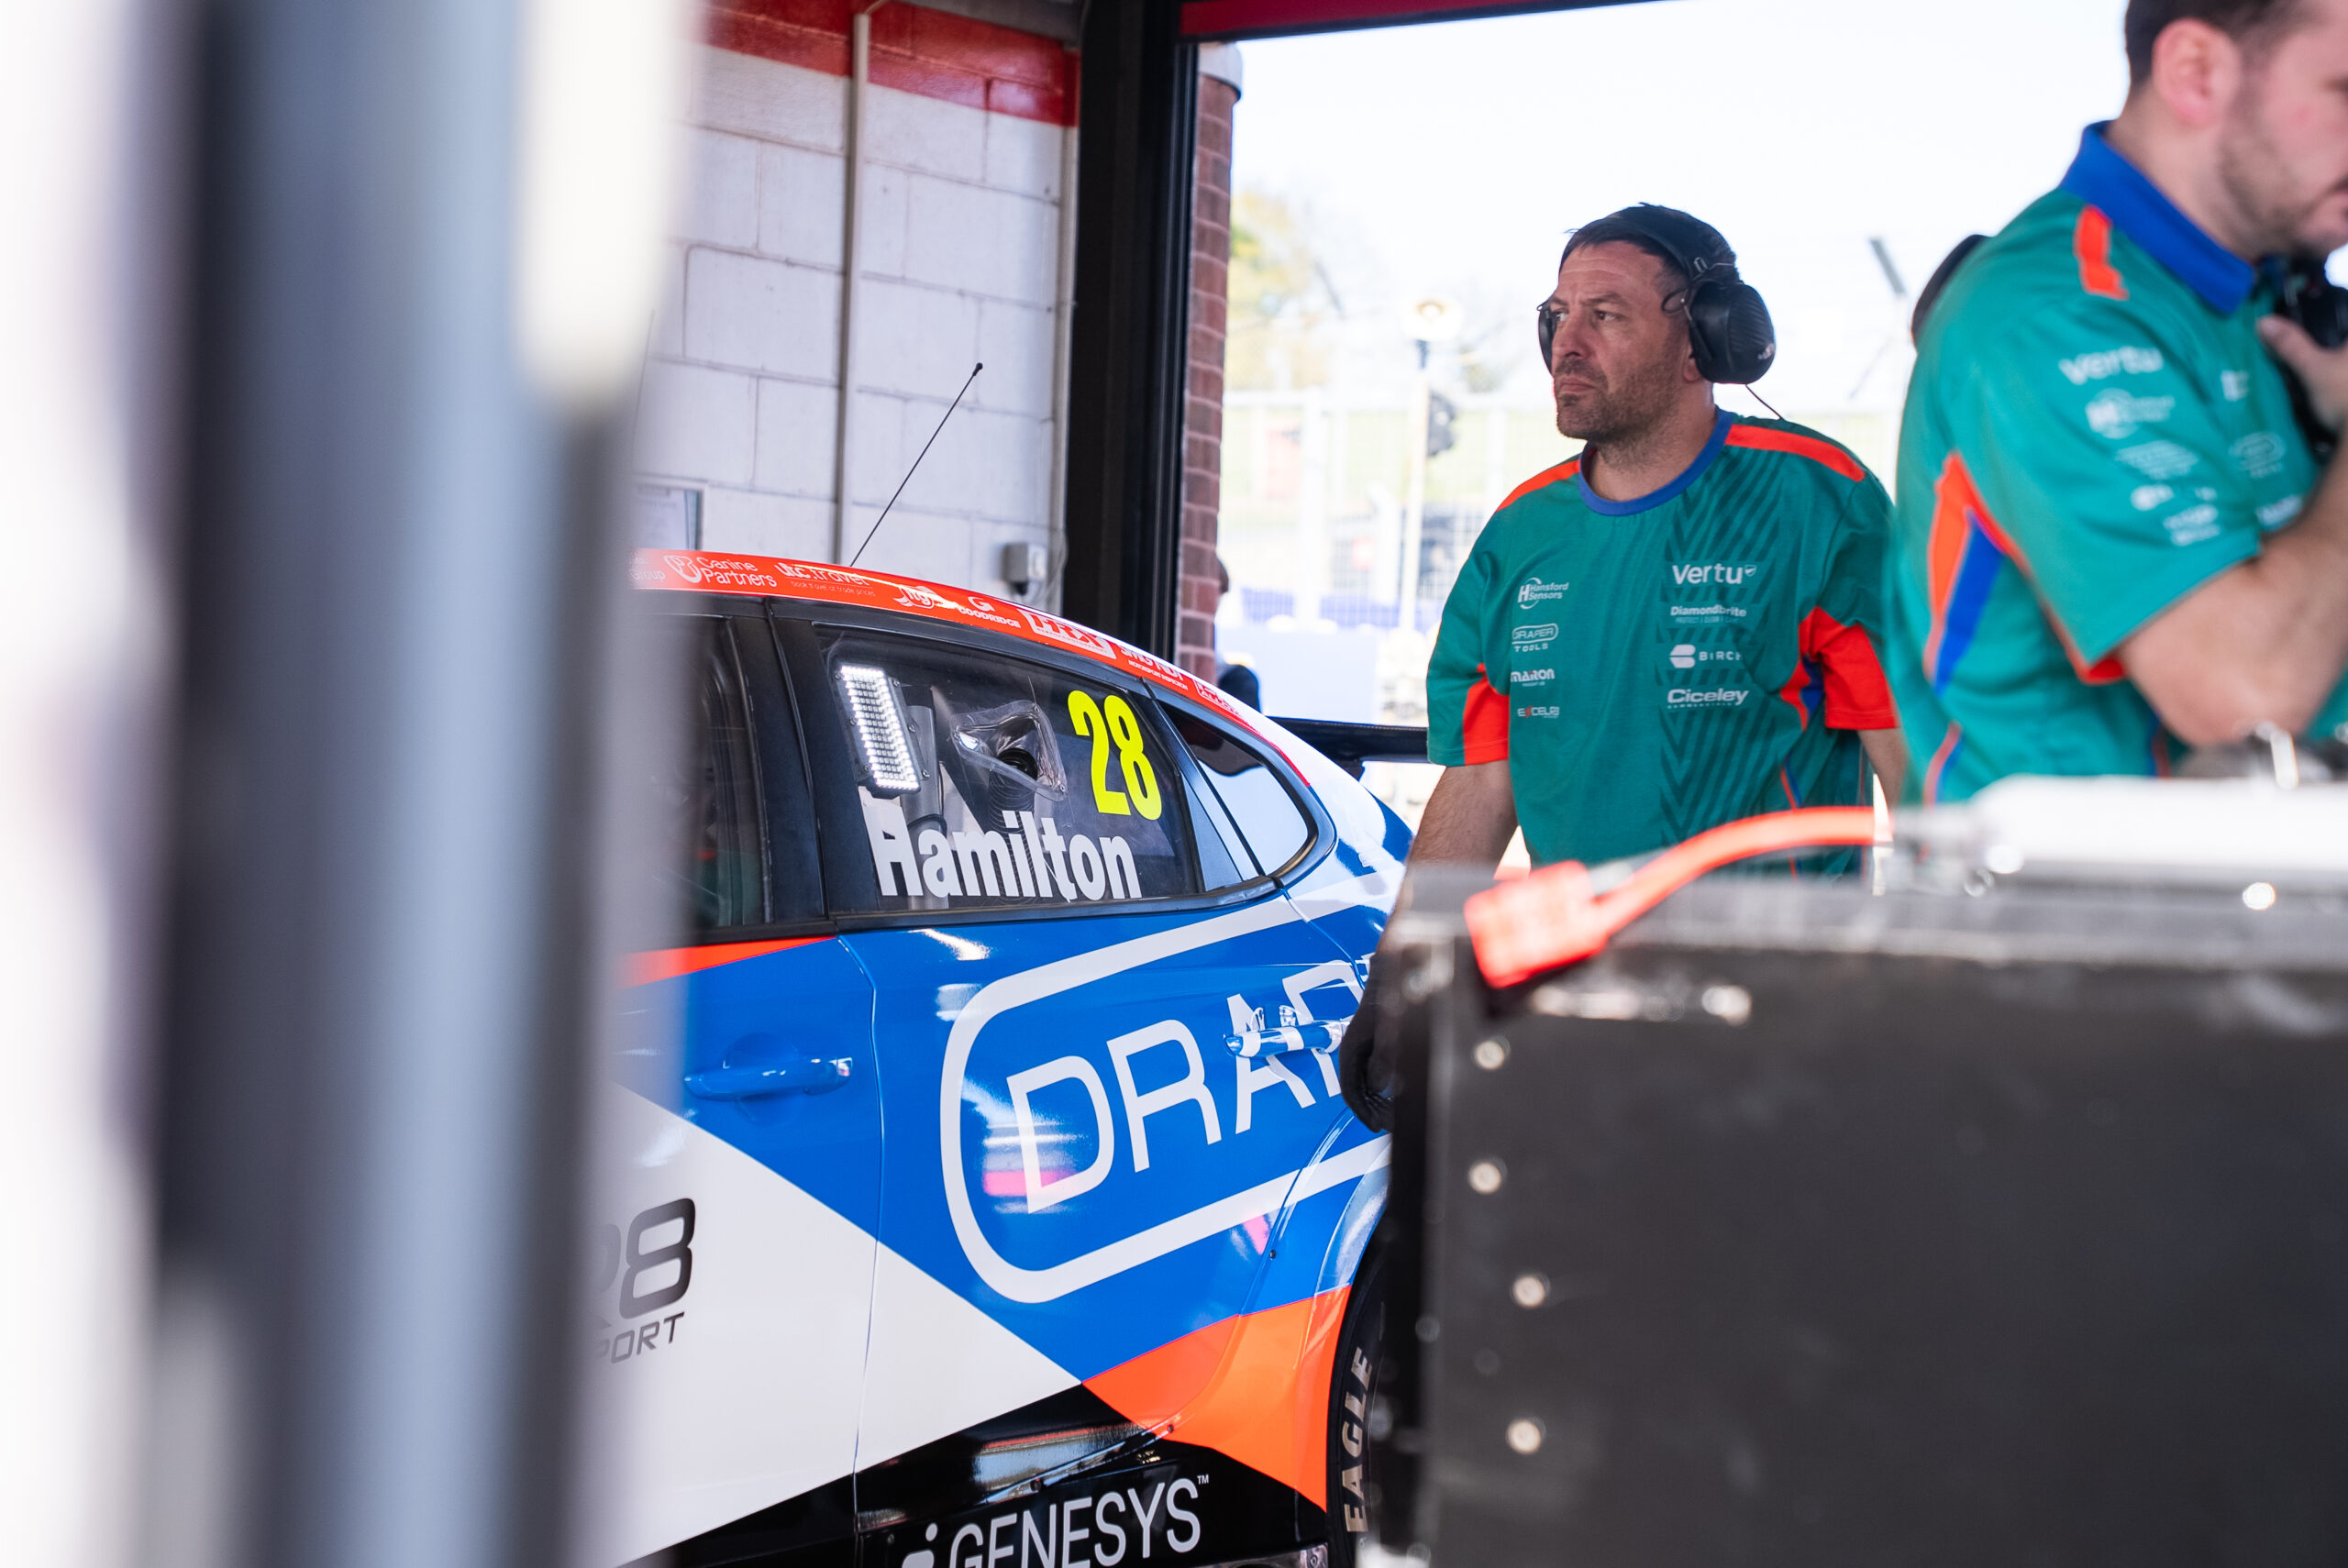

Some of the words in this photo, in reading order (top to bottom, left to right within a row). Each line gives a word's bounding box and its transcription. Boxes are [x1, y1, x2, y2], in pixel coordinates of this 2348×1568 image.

[696, 557, 758, 572] Canine
[1672, 562, 1744, 584] Vertu
[700, 567, 778, 588] Partners
[1530, 581, 1569, 592] Hansford
[1528, 591, 1564, 601] Sensors
[1670, 604, 1747, 617] Diamondbrite
[1514, 642, 1549, 653] TOOLS
[1667, 688, 1749, 706] Ciceley
[1068, 690, 1163, 821] 28
[863, 805, 1143, 900] Hamilton
[1006, 950, 1376, 1215] DRAP
[1342, 1346, 1373, 1533] EAGLE
[948, 1477, 1202, 1568] GENESYS
